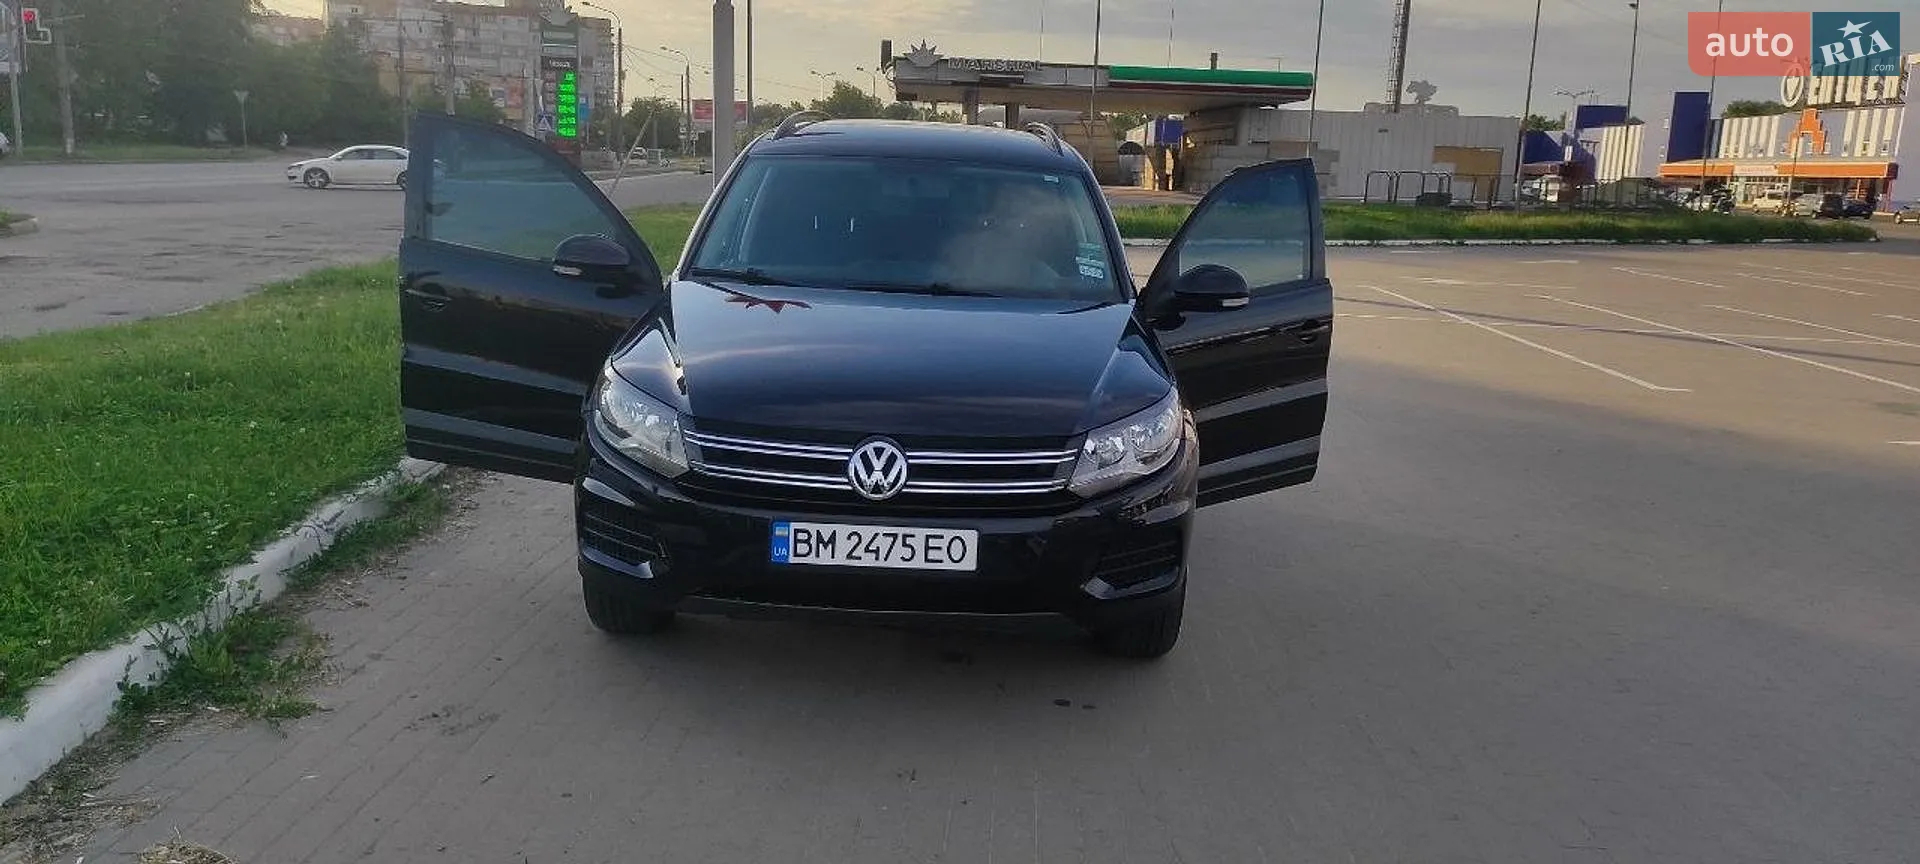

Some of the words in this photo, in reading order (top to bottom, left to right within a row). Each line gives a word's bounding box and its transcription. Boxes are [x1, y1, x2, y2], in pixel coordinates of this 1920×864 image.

[948, 57, 1043, 72] MARSHAL
[773, 546, 788, 557] UA
[793, 528, 837, 559] BM
[846, 531, 916, 562] 2475
